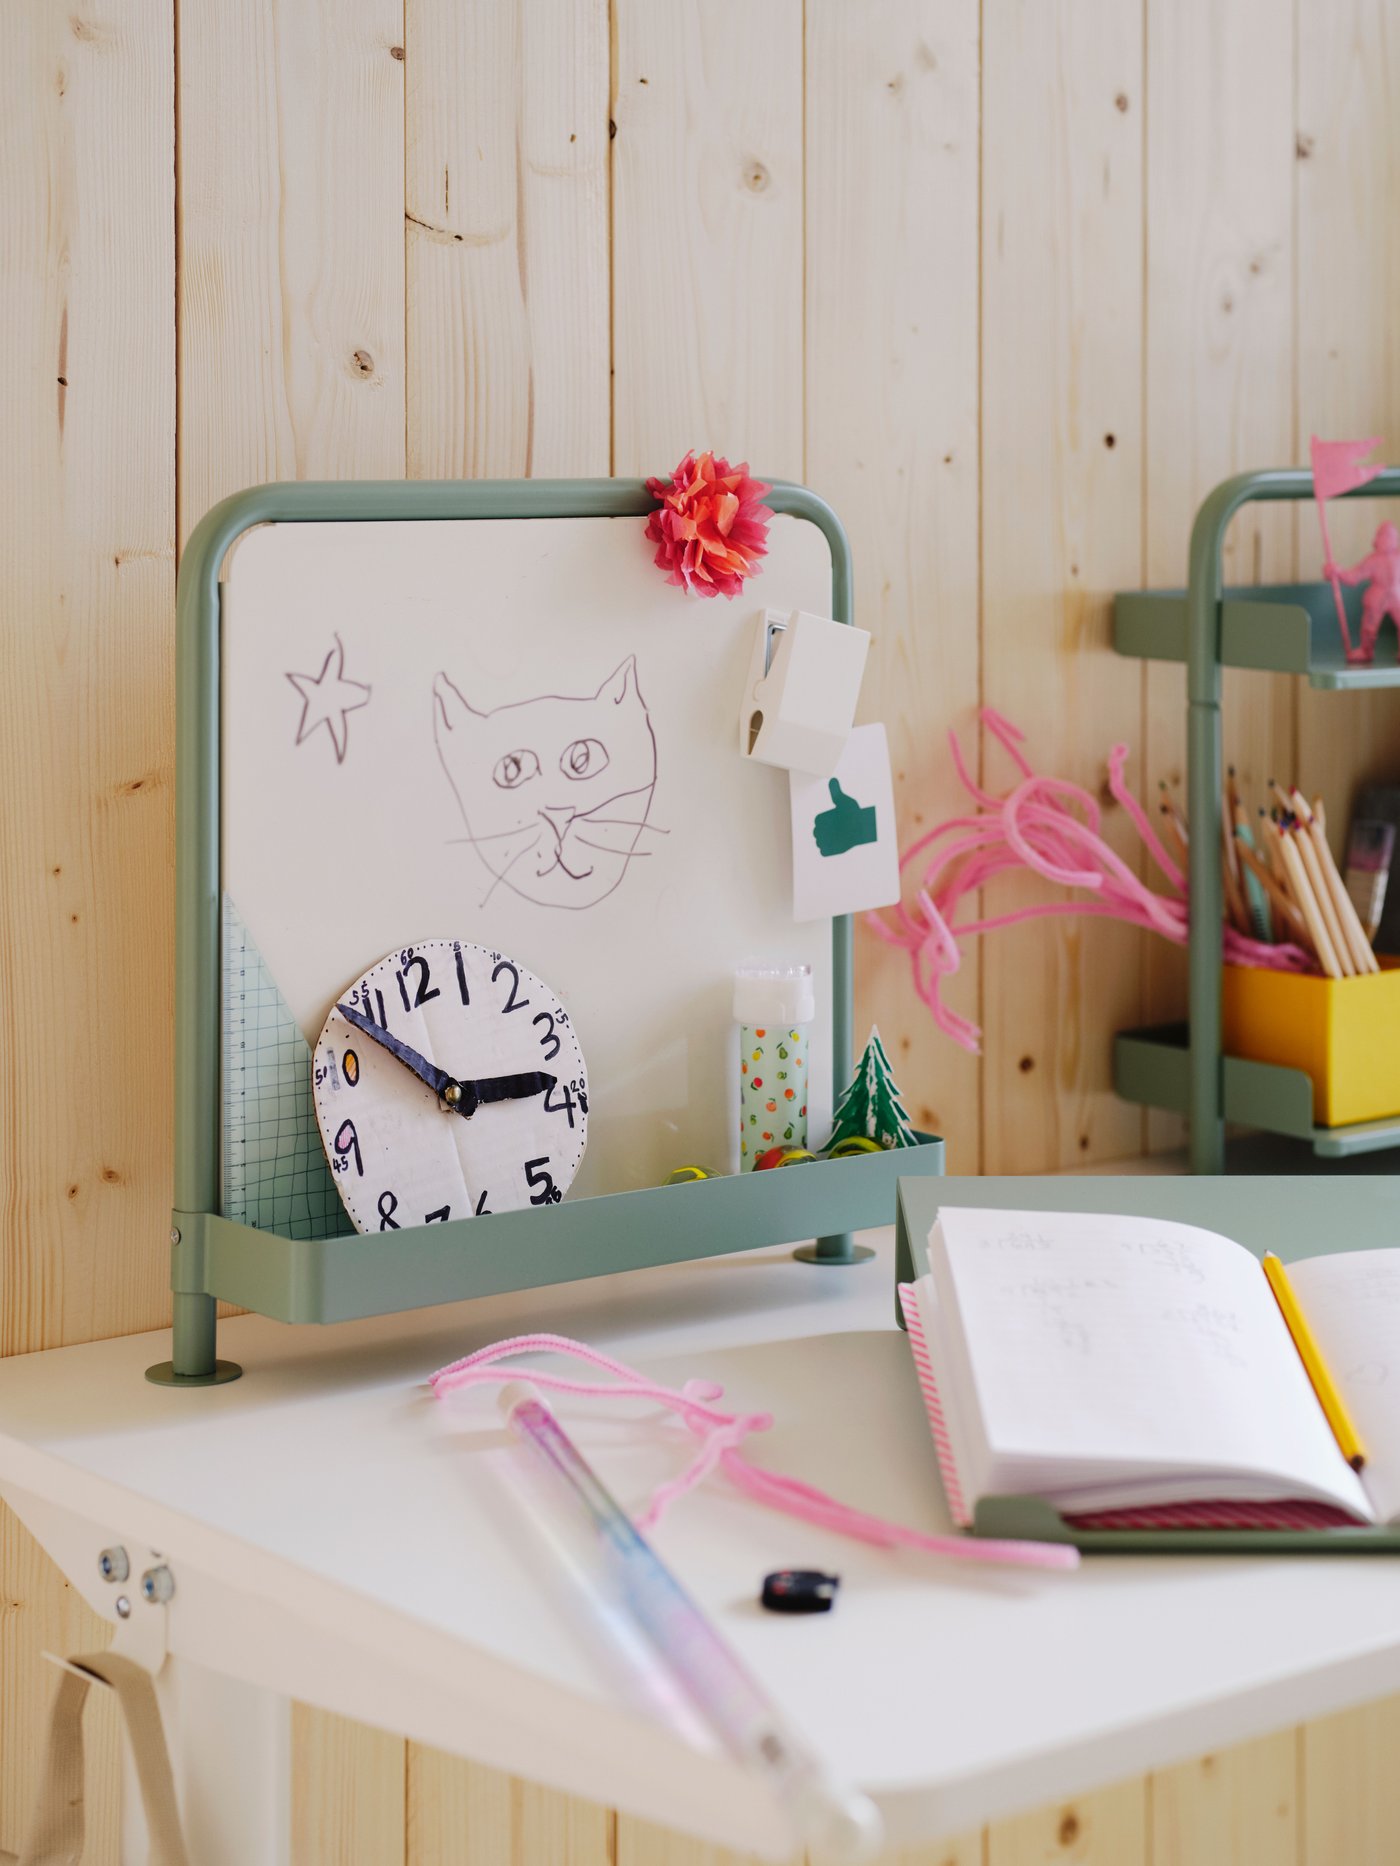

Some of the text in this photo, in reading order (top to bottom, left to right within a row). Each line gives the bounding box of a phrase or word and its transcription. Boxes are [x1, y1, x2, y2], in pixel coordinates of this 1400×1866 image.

[400, 948, 414, 965] 60
[455, 951, 470, 1005] 1
[349, 984, 369, 1005] 55
[396, 956, 440, 1012] 12
[492, 961, 530, 1013] 2
[533, 1012, 560, 1061] 3
[544, 1085, 576, 1128] 4
[571, 1079, 586, 1092] 20
[333, 1159, 348, 1173] 45
[334, 1119, 363, 1176] 9
[525, 1157, 553, 1205] 5
[378, 1191, 401, 1232] 8
